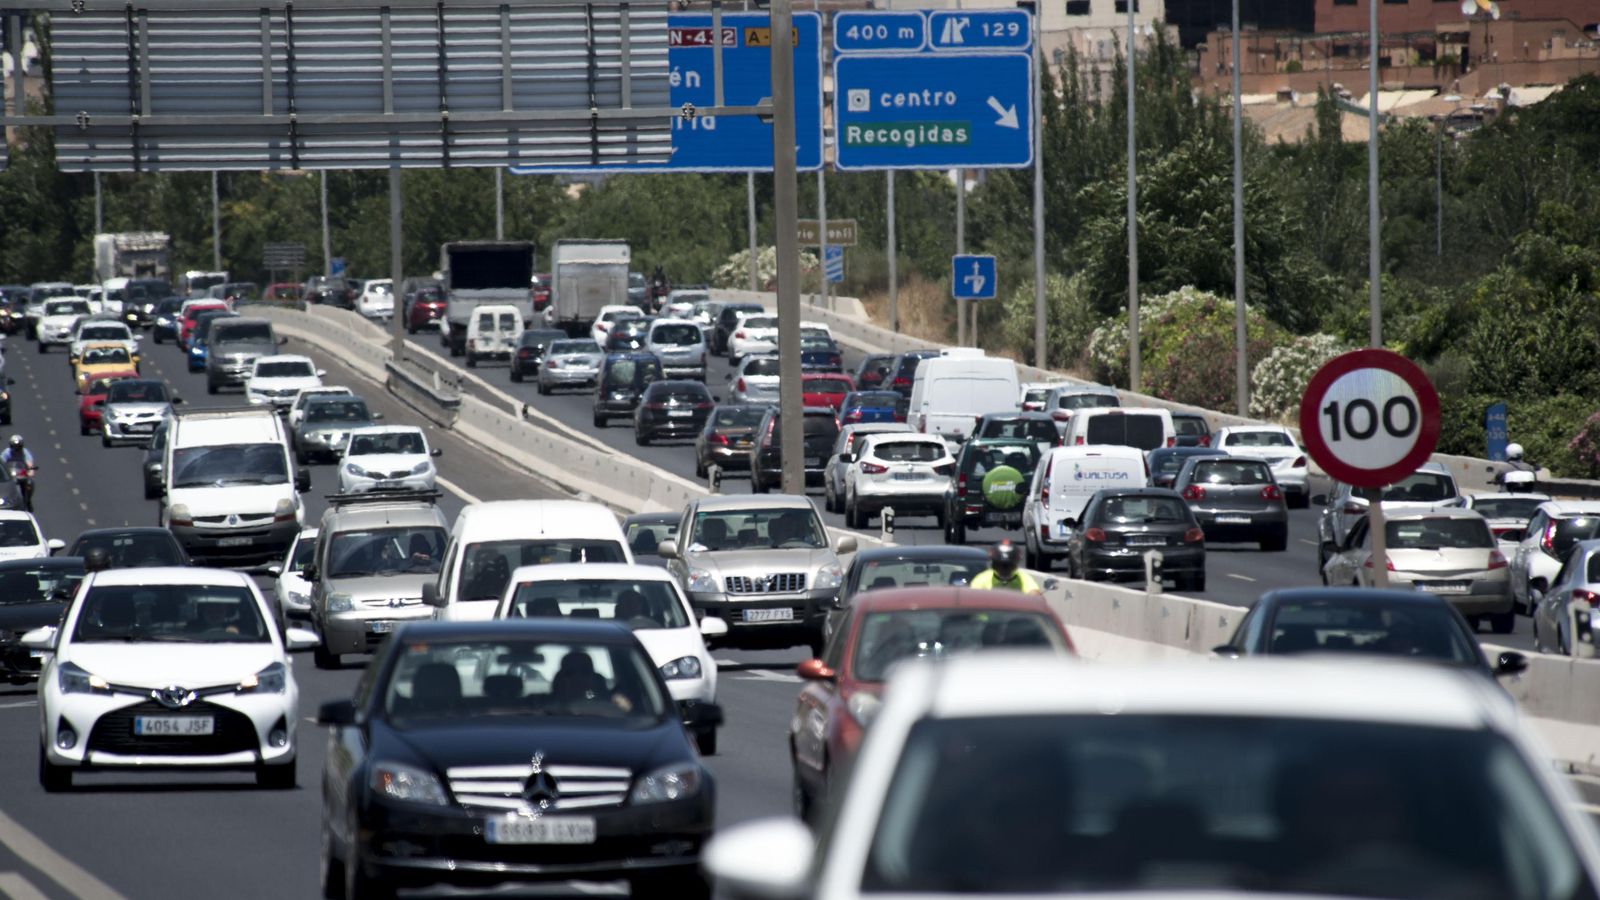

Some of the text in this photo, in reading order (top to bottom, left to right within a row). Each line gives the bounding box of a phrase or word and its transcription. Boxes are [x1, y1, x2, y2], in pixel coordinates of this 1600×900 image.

[846, 25, 915, 40] 400 m
[982, 22, 1020, 37] 129
[880, 89, 957, 107] centro
[847, 125, 968, 147] Recogidas
[1323, 396, 1418, 441] 100
[145, 720, 210, 733] 4054 JSF
